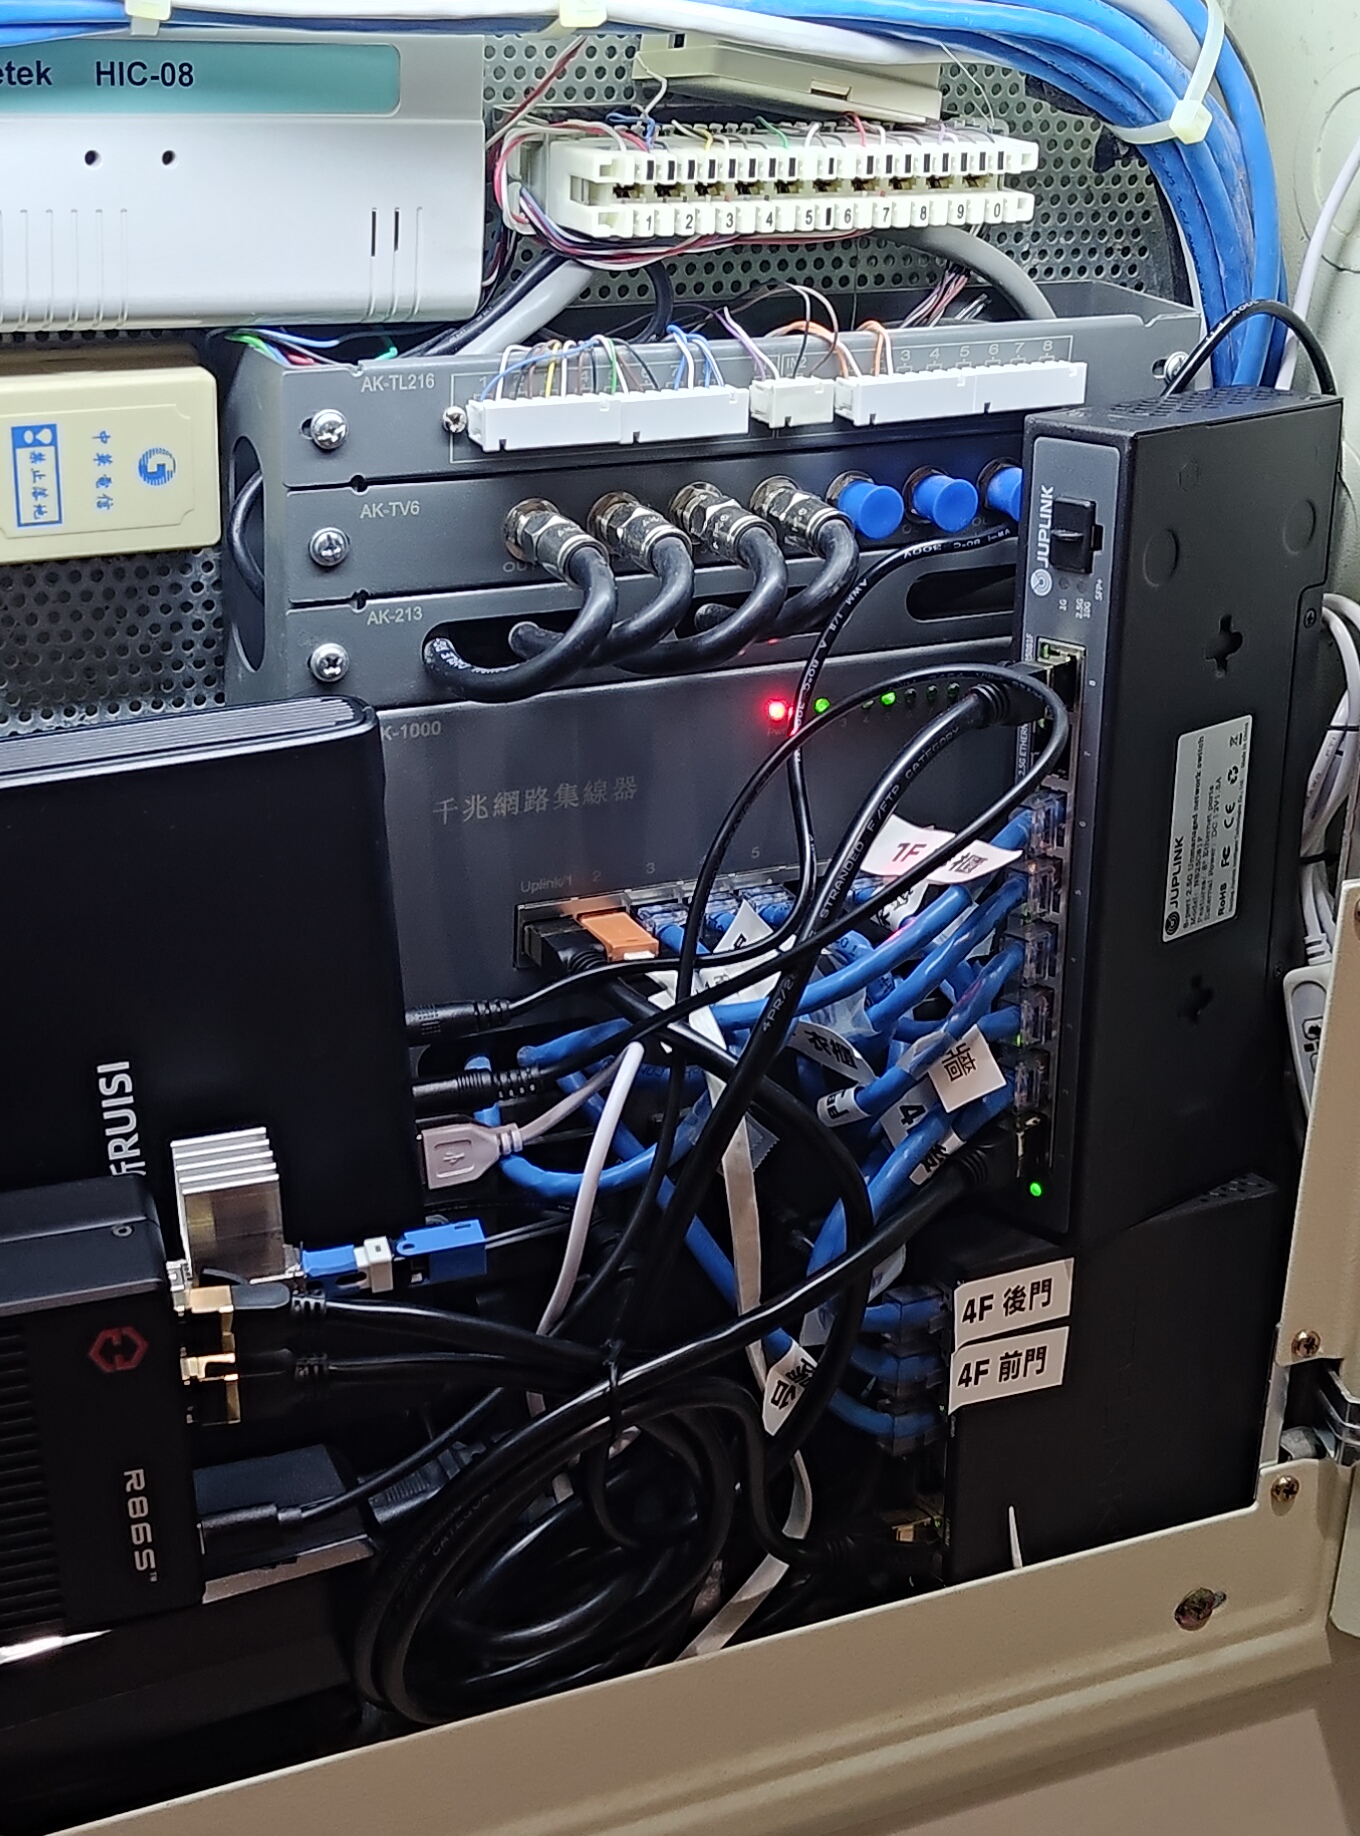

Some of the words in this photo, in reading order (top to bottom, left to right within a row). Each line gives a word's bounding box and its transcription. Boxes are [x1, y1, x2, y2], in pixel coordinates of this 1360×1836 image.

[95, 61, 195, 88] HIC-08
[646, 216, 651, 230] 1
[685, 214, 693, 229] 2
[726, 213, 733, 228] 3
[766, 212, 773, 226] 4
[806, 210, 813, 225] 5
[844, 209, 852, 224] 6
[883, 208, 891, 222] 7
[920, 206, 927, 220] 8
[957, 205, 965, 218] 9
[994, 204, 1001, 217] 0
[901, 350, 911, 360] 3
[929, 348, 940, 358] 4
[960, 346, 970, 357] 5
[989, 344, 999, 355] 6
[1014, 342, 1024, 353] 7
[1043, 340, 1053, 351] 8
[361, 373, 435, 393] AK-TL216
[360, 500, 420, 520] AK-TV6
[1037, 485, 1054, 568] JUPLINK
[845, 578, 868, 606] AWM
[366, 605, 424, 625] AK-213
[380, 721, 441, 741] K-1000
[1018, 724, 1029, 757] ETHERN
[1196, 736, 1205, 769] switch
[432, 775, 638, 825] 千兆網路集線器
[1193, 770, 1202, 811] network
[819, 841, 864, 919] STRANDED
[904, 724, 960, 779] CATEGORY
[646, 863, 656, 875] 3
[750, 847, 761, 859] 5
[891, 842, 928, 863] 1F
[1169, 835, 1184, 909] JUPLINK
[1217, 882, 1228, 916] RoHS
[941, 1042, 977, 1082] 牆
[961, 1293, 995, 1325] 4F
[1002, 1277, 1053, 1317] 後門
[957, 1358, 991, 1389] 4F
[997, 1345, 1048, 1383] 前門
[123, 1469, 156, 1571] R86S
